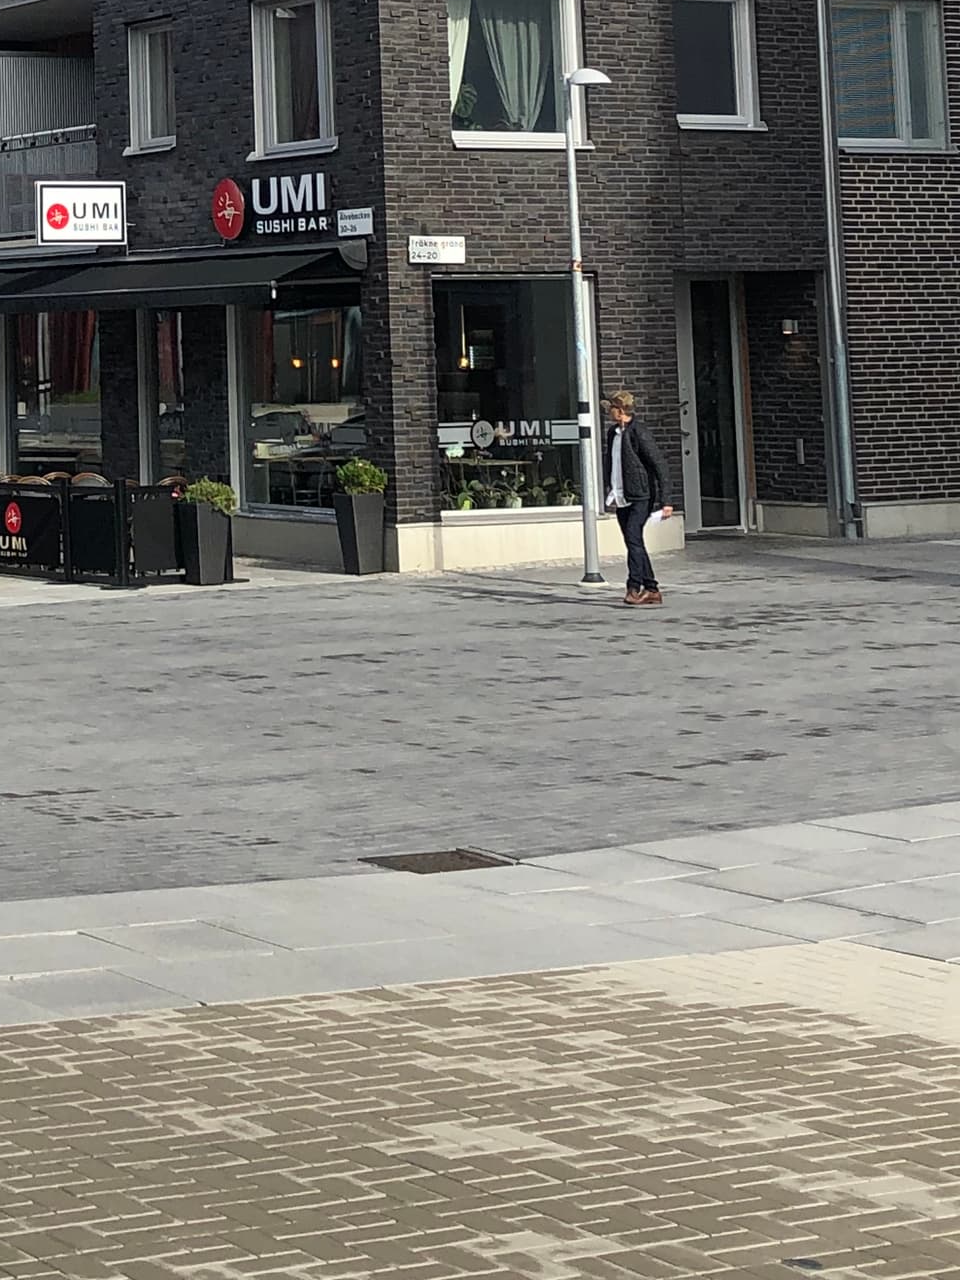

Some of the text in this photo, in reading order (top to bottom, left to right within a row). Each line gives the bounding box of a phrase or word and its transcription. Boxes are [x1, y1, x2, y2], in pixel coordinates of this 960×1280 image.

[251, 172, 326, 215] UMI
[73, 202, 118, 219] UMI
[73, 223, 99, 231] SUSHI
[256, 216, 328, 235] SUSHI BAR
[411, 251, 438, 260] 24-20
[497, 420, 551, 437] UMI
[499, 438, 551, 446] SUSHI BAR
